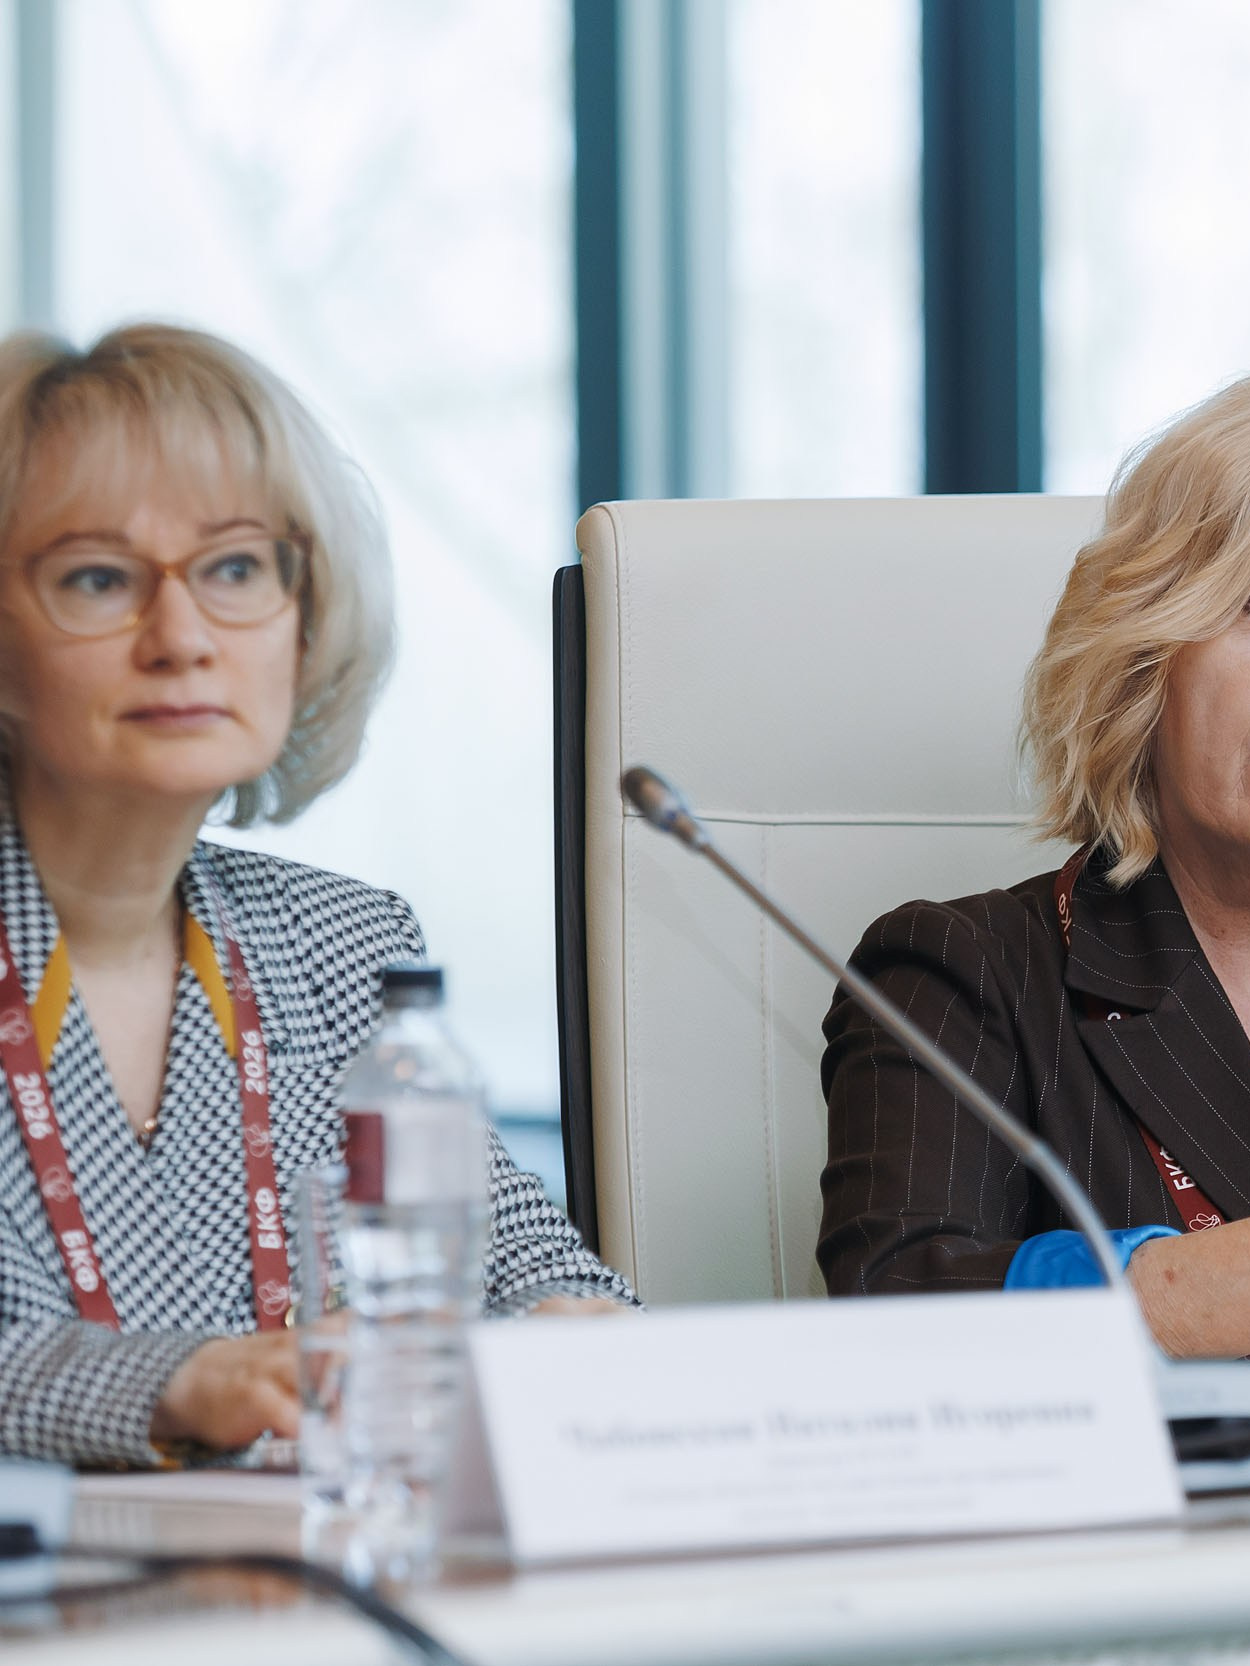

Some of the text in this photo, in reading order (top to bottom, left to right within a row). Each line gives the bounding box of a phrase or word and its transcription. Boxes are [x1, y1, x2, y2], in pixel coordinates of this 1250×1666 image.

[241, 1030, 267, 1095] 2026
[12, 1072, 55, 1140] 2026
[254, 1187, 283, 1249] БКФ
[61, 1229, 99, 1293] БКФ
